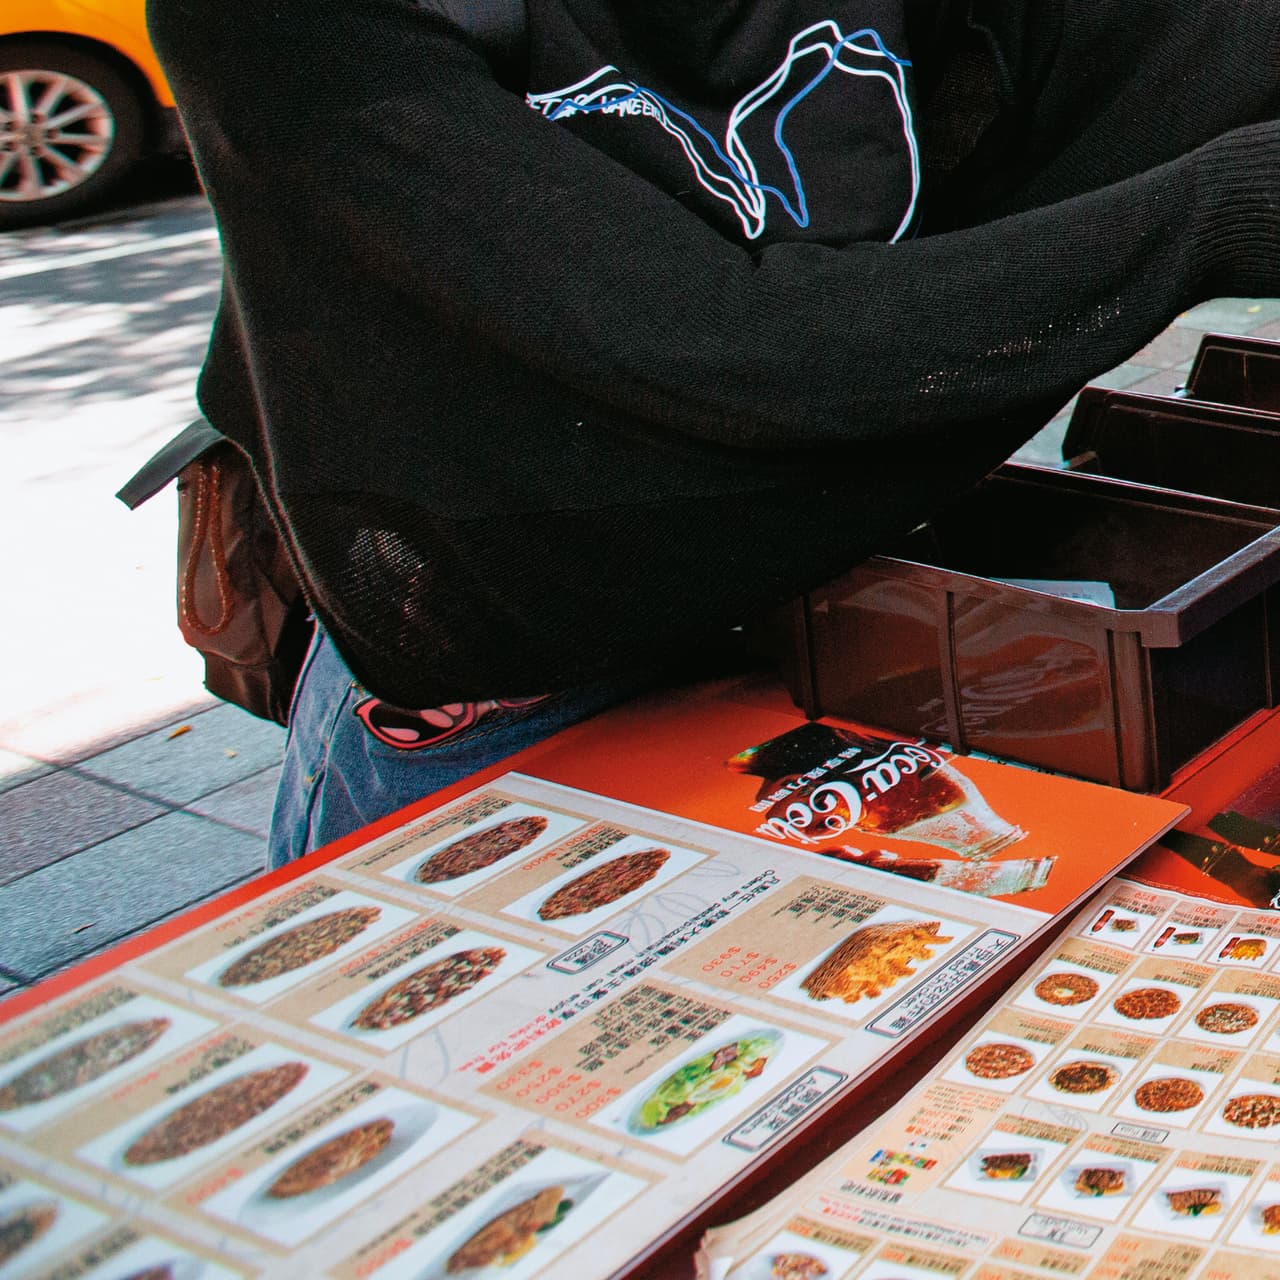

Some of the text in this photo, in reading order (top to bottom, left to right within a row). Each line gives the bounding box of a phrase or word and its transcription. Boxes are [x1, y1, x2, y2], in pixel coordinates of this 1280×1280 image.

[754, 738, 945, 845] Coca-Cola
[738, 868, 778, 890] Orders
[718, 889, 743, 902] any
[631, 901, 726, 958] pasta/pizza/main
[560, 938, 604, 962] Pizza
[570, 941, 615, 965] 披薩
[696, 945, 745, 973] $930
[715, 950, 763, 978] $710
[604, 958, 638, 977] meal
[734, 956, 781, 984] $490
[753, 961, 800, 990] $250
[898, 946, 984, 1010] Fried chicken
[579, 977, 607, 992] can
[887, 937, 1011, 1031] 天母最好吃的炸雞
[544, 992, 585, 1015] enjoy
[505, 1014, 551, 1040] drinks
[484, 1040, 511, 1054] for
[548, 1078, 607, 1113] $270
[569, 1085, 626, 1120] $300
[737, 1075, 821, 1137] Appetizers
[761, 1086, 825, 1131] 開胃菜
